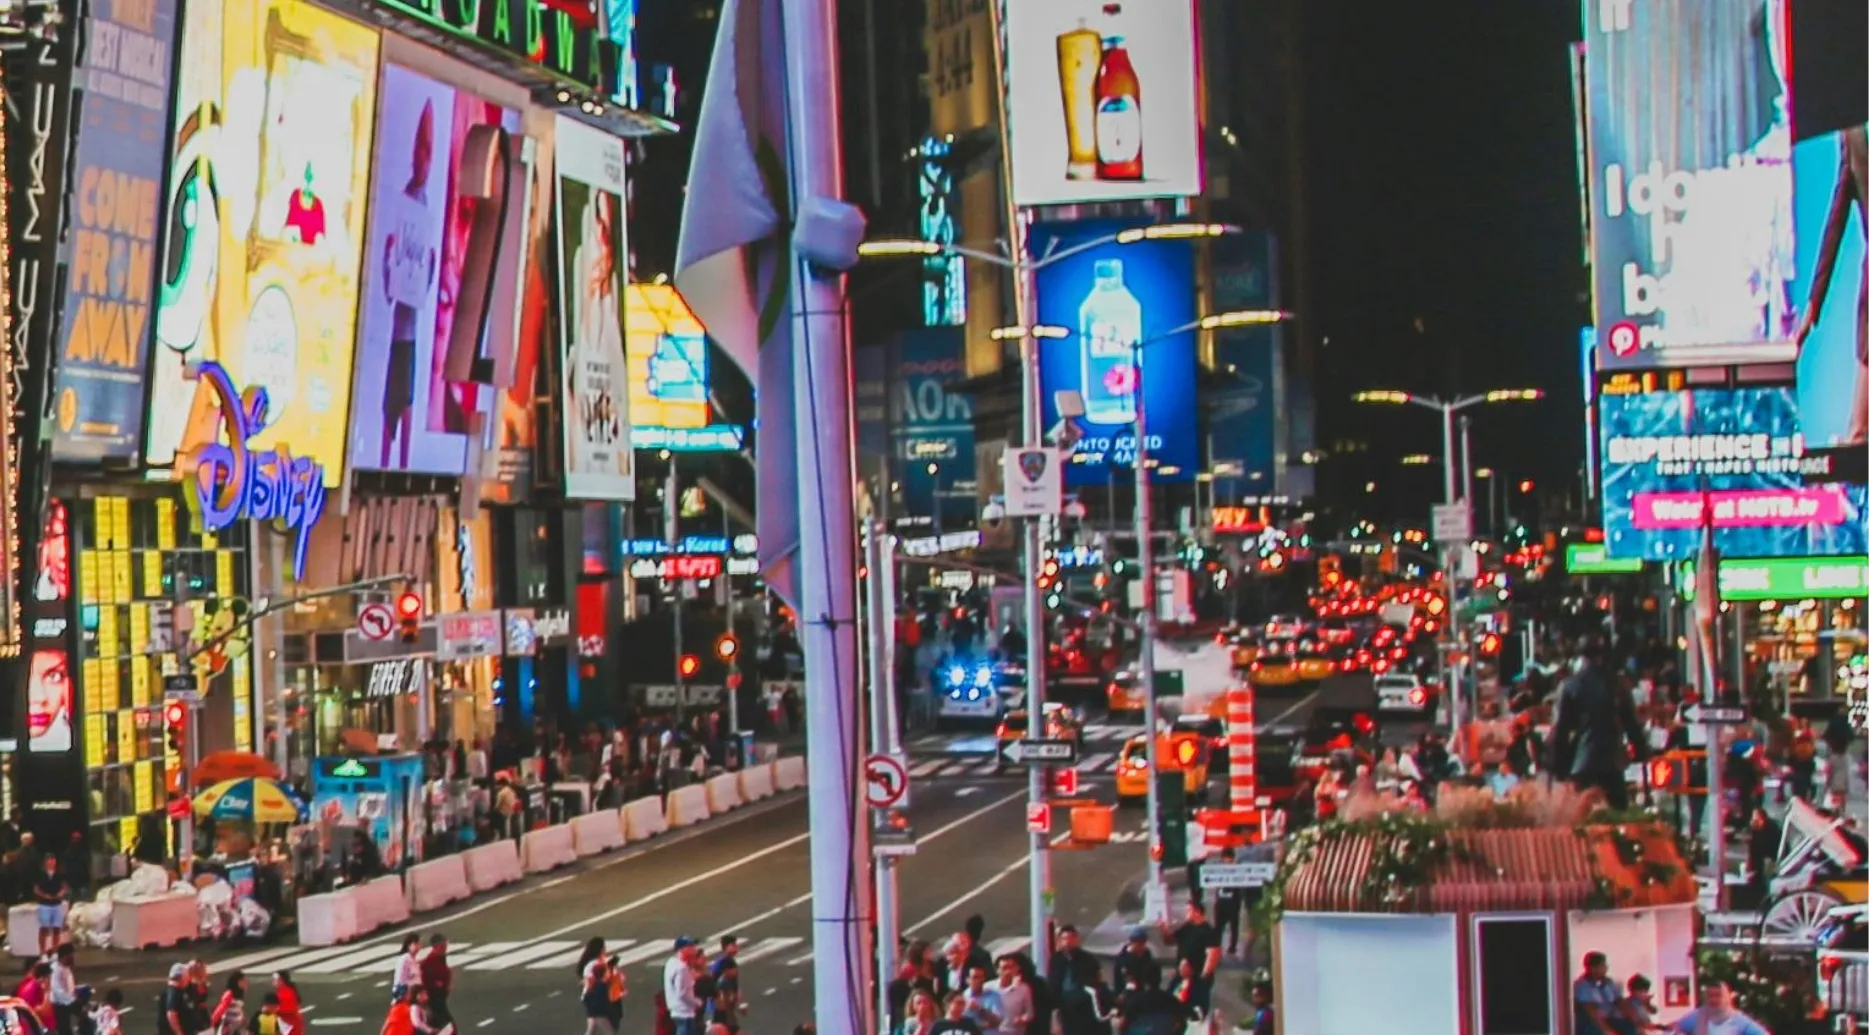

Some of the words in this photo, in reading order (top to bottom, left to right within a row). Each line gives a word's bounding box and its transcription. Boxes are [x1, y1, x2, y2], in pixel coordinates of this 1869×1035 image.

[79, 165, 157, 240] COME
[73, 228, 152, 305] FROM
[65, 296, 147, 368] AWAY
[1608, 433, 1770, 464] EXPERIENCE
